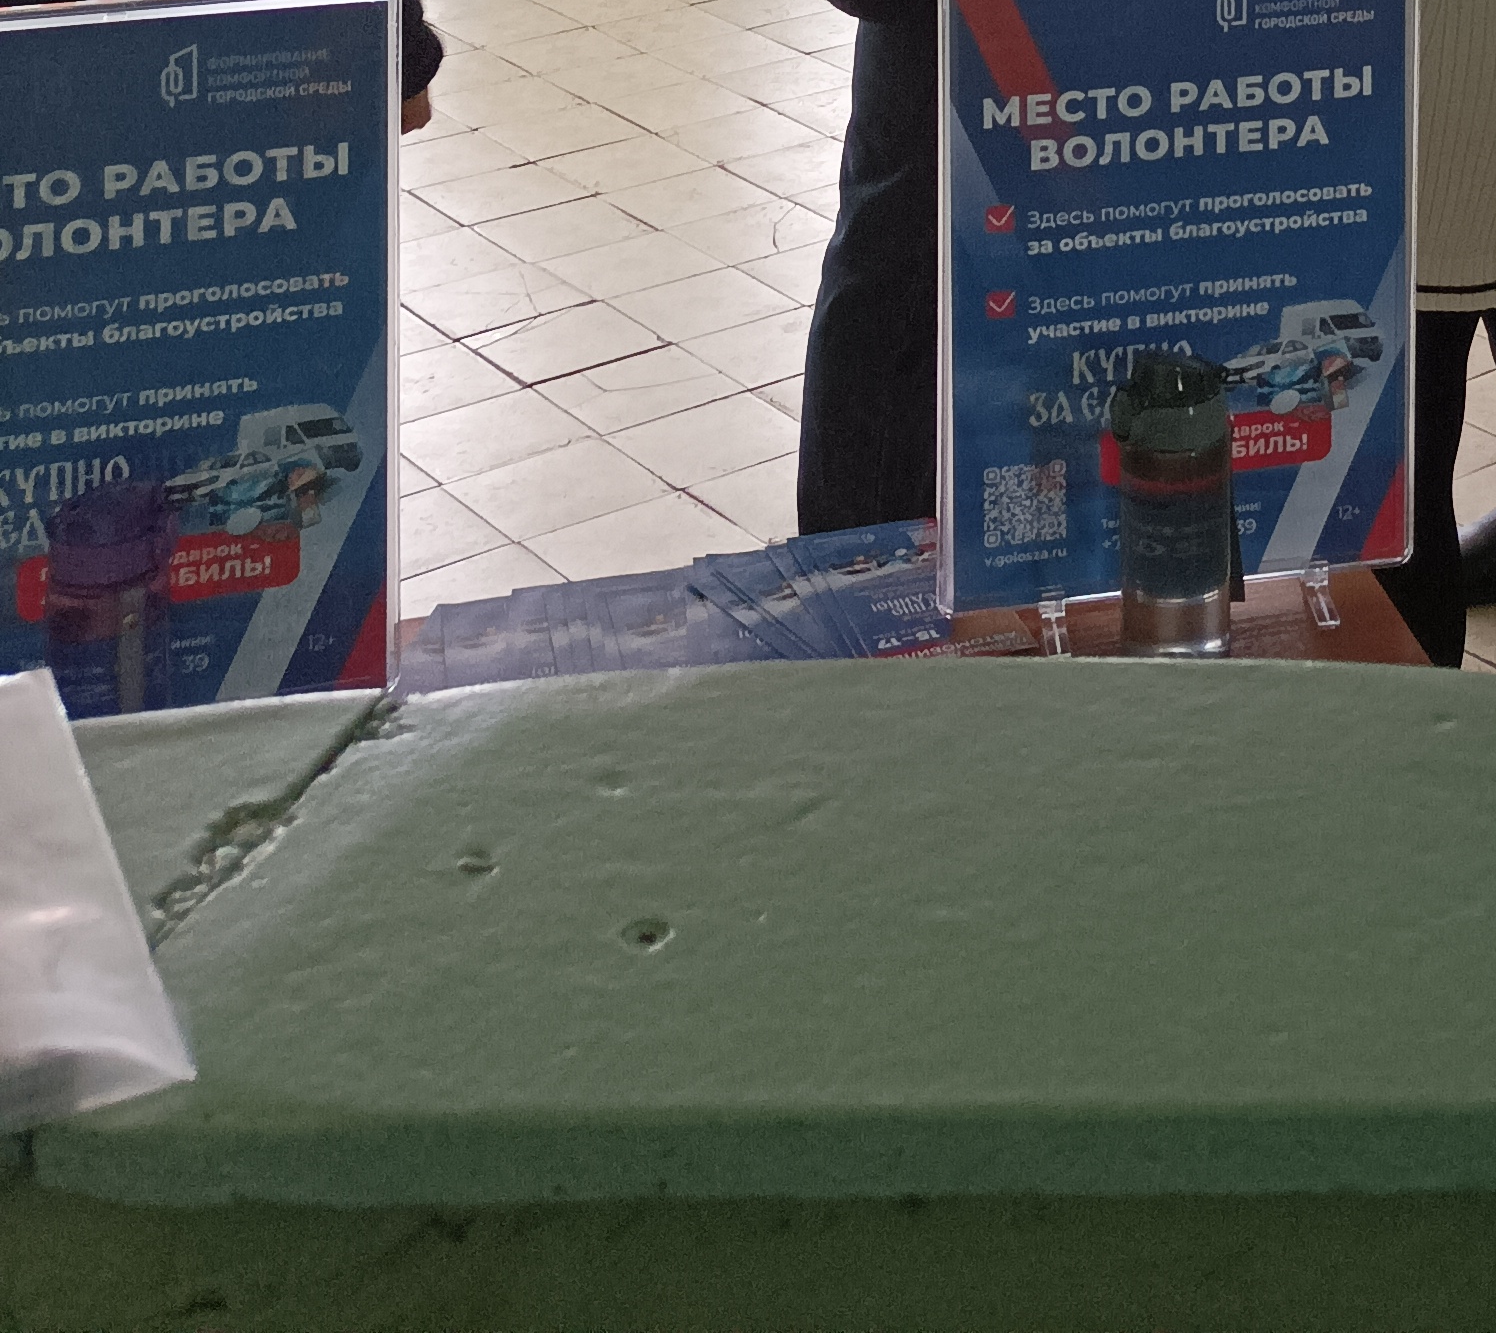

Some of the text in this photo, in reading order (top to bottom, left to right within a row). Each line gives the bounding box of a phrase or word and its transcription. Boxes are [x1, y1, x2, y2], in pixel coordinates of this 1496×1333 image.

[1254, 9, 1375, 30] ГОРОДСКОЙ СРЕДЫ
[207, 81, 352, 103] ГОРОДСКОЙ СРЕДЫ
[982, 65, 1373, 130] МЕСТО РАБОТЫ
[1030, 114, 1330, 171] ВОЛОНТЕРА
[104, 142, 349, 200] РАБОТЫ
[1027, 183, 1373, 230] Здесь помогут проголосовать
[1027, 209, 1368, 256] за объекты благоустройства
[18, 272, 349, 325] помогут проголосовать
[1027, 273, 1298, 315] Здесь помогут принять
[102, 301, 343, 343] благоустройства
[1027, 301, 1270, 345] участие в викторине
[19, 391, 131, 420] помогут
[139, 377, 258, 407] принять
[50, 428, 67, 445] в
[73, 409, 225, 444] викторине
[1336, 504, 1360, 520] 12+
[170, 556, 272, 587] БИЛЬ!
